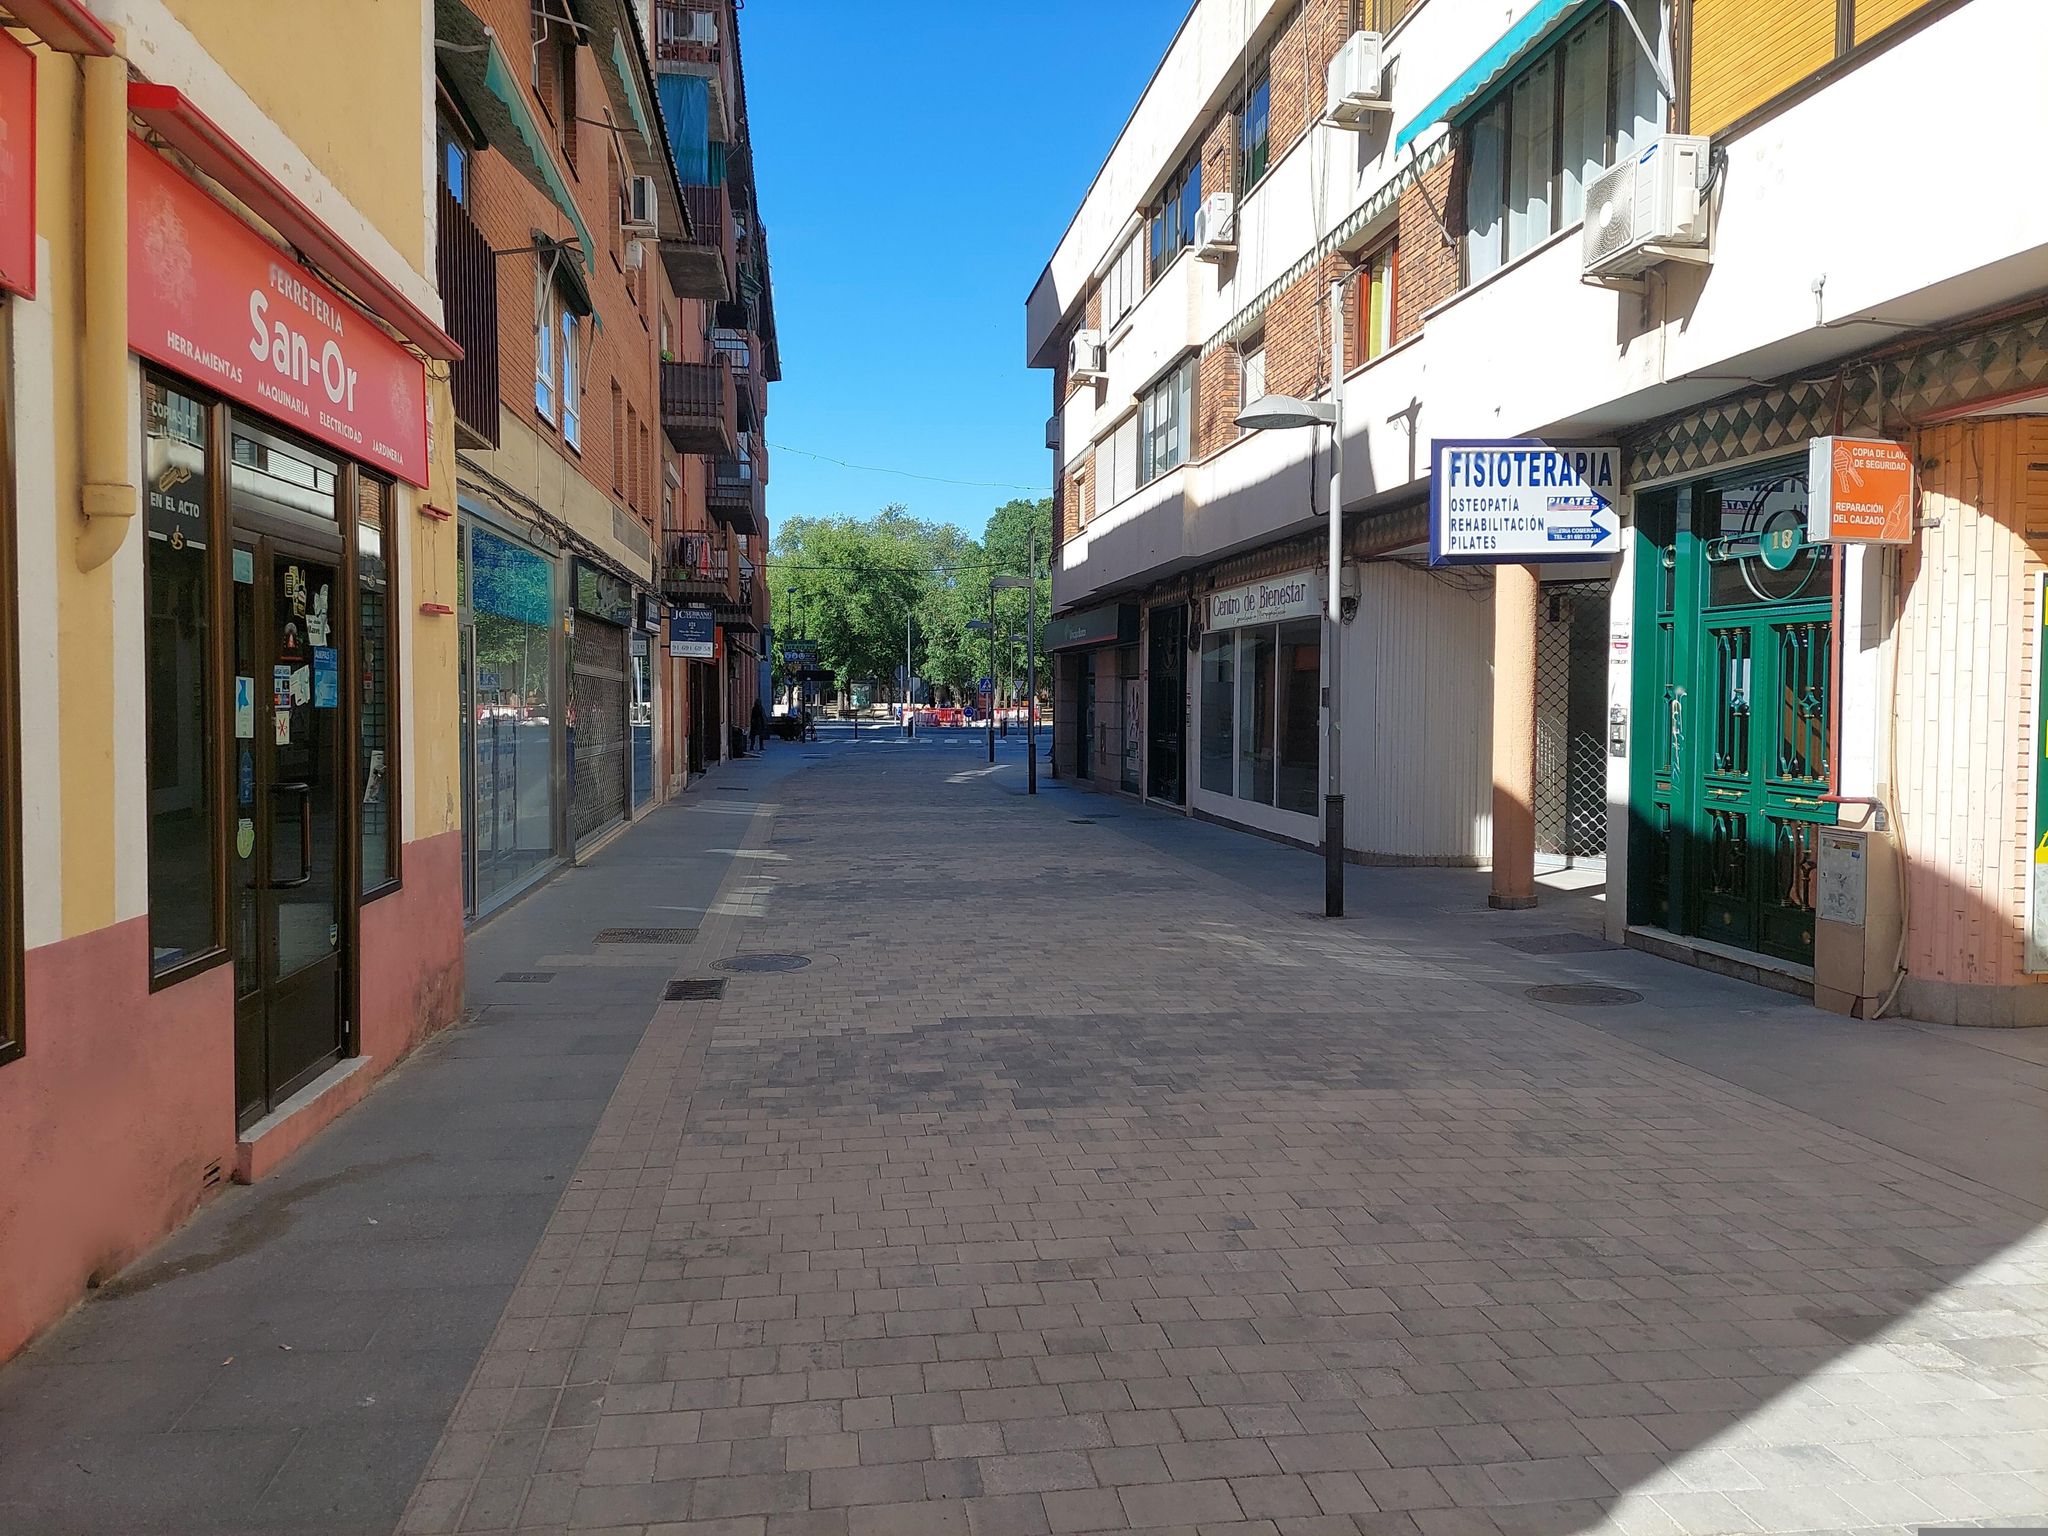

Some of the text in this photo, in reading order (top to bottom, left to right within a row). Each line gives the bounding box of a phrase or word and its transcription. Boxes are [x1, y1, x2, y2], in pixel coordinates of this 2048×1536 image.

[249, 289, 358, 412] San-Or
[167, 330, 404, 465] HERRAMIENTAS MAQUINARIA ELECTRICIDAD JARDINERIA
[151, 401, 198, 431] COPIAS DE
[1853, 447, 1874, 458] COPIA
[1876, 449, 1885, 458] DE
[1450, 451, 1613, 487] FISIOTERAPIA
[1854, 459, 1906, 471] DE SEGURIDAD
[150, 491, 200, 518] EN EL ACTO
[1451, 495, 1520, 512] OSTEOPATÍA
[1548, 497, 1599, 505] PILATES
[1836, 502, 1884, 513] REPARACIÓN
[1451, 514, 1545, 531] REHABILITACIÓN
[1834, 514, 1885, 525] DEL CALZADO
[1451, 536, 1497, 550] PILATES
[1771, 529, 1794, 550] 18
[1213, 595, 1240, 617] Centro
[1243, 587, 1256, 612] de
[1259, 581, 1306, 609] Bienestar
